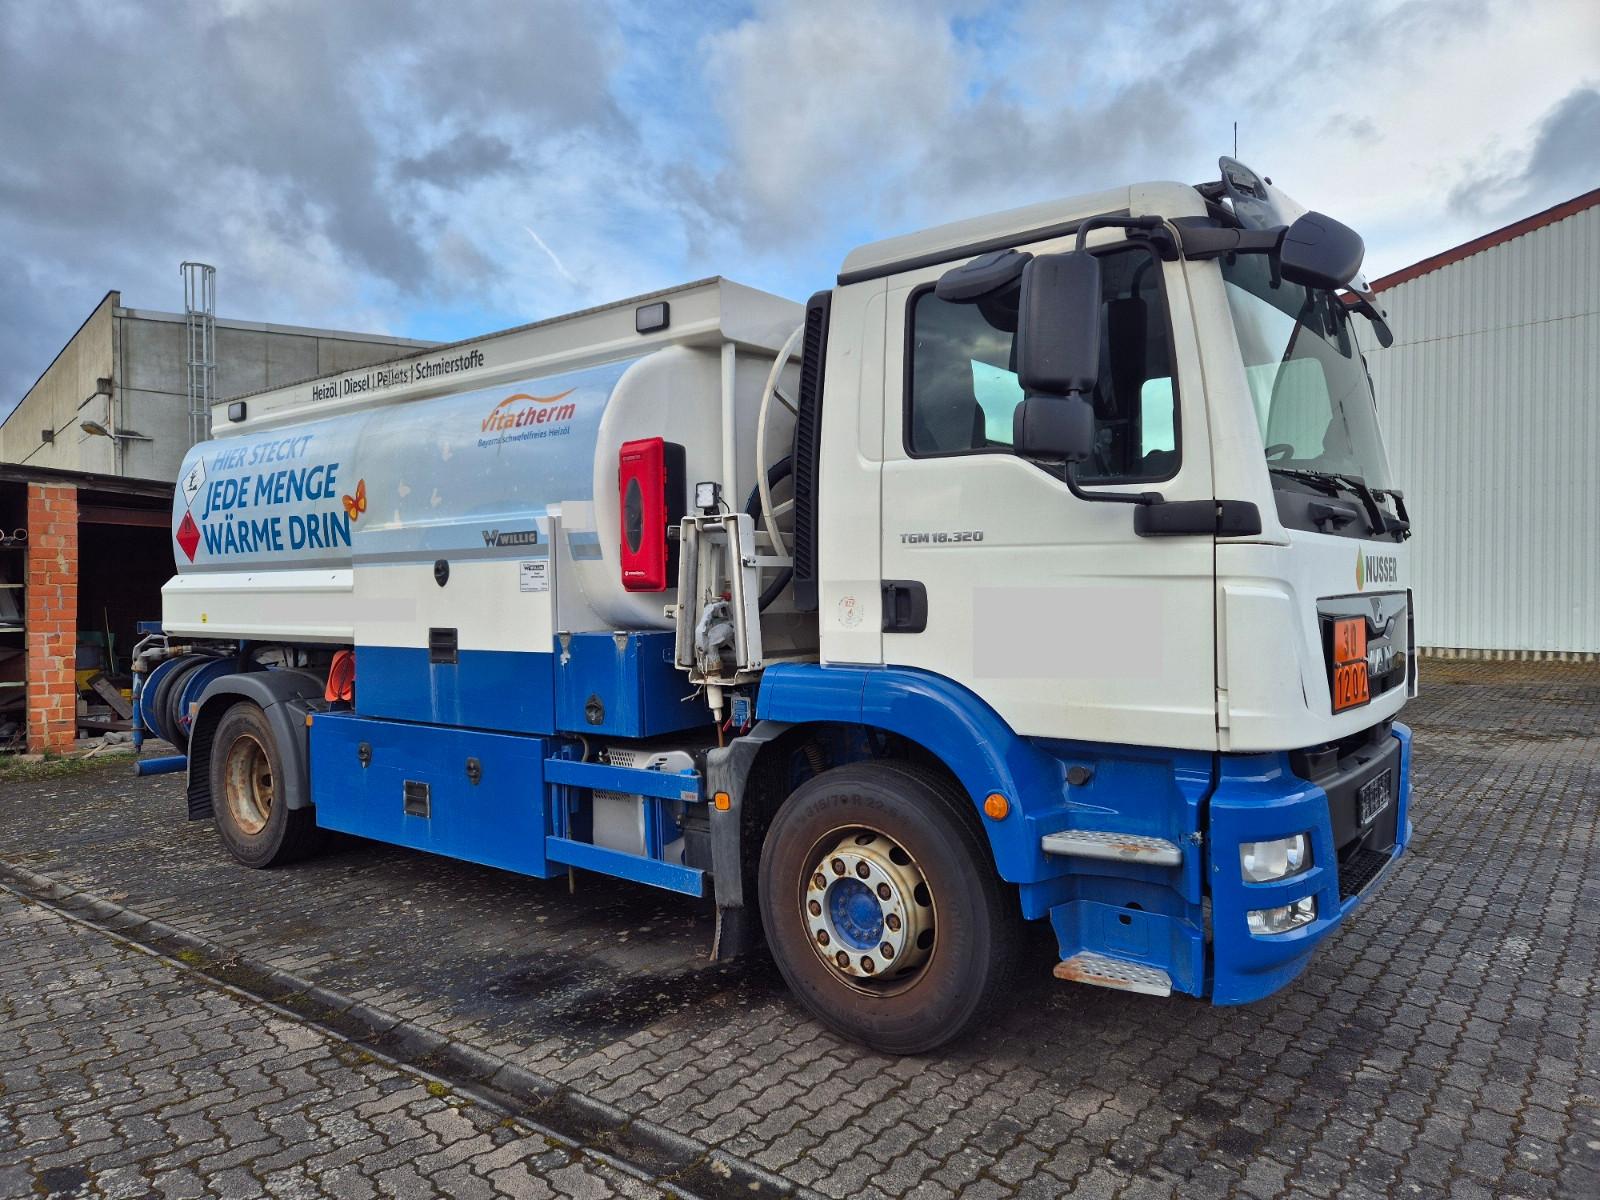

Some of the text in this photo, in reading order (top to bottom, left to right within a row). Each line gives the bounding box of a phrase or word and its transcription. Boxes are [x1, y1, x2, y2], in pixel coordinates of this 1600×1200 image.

[312, 382, 338, 401] Heizöl
[344, 374, 370, 395] Diesel
[377, 368, 408, 387] Pellets
[415, 349, 484, 380] Schmierstoffe
[548, 426, 570, 437] Heizöl
[212, 435, 314, 471] HIER STECKT
[202, 463, 339, 520] JEDE MENGE
[202, 511, 353, 555] WÄRME DRIN
[500, 532, 536, 545] WILLIG
[900, 531, 984, 544] TGM 18.320
[1366, 555, 1397, 582] NUSSER
[1343, 623, 1357, 657] 30
[1337, 665, 1367, 706] 1202
